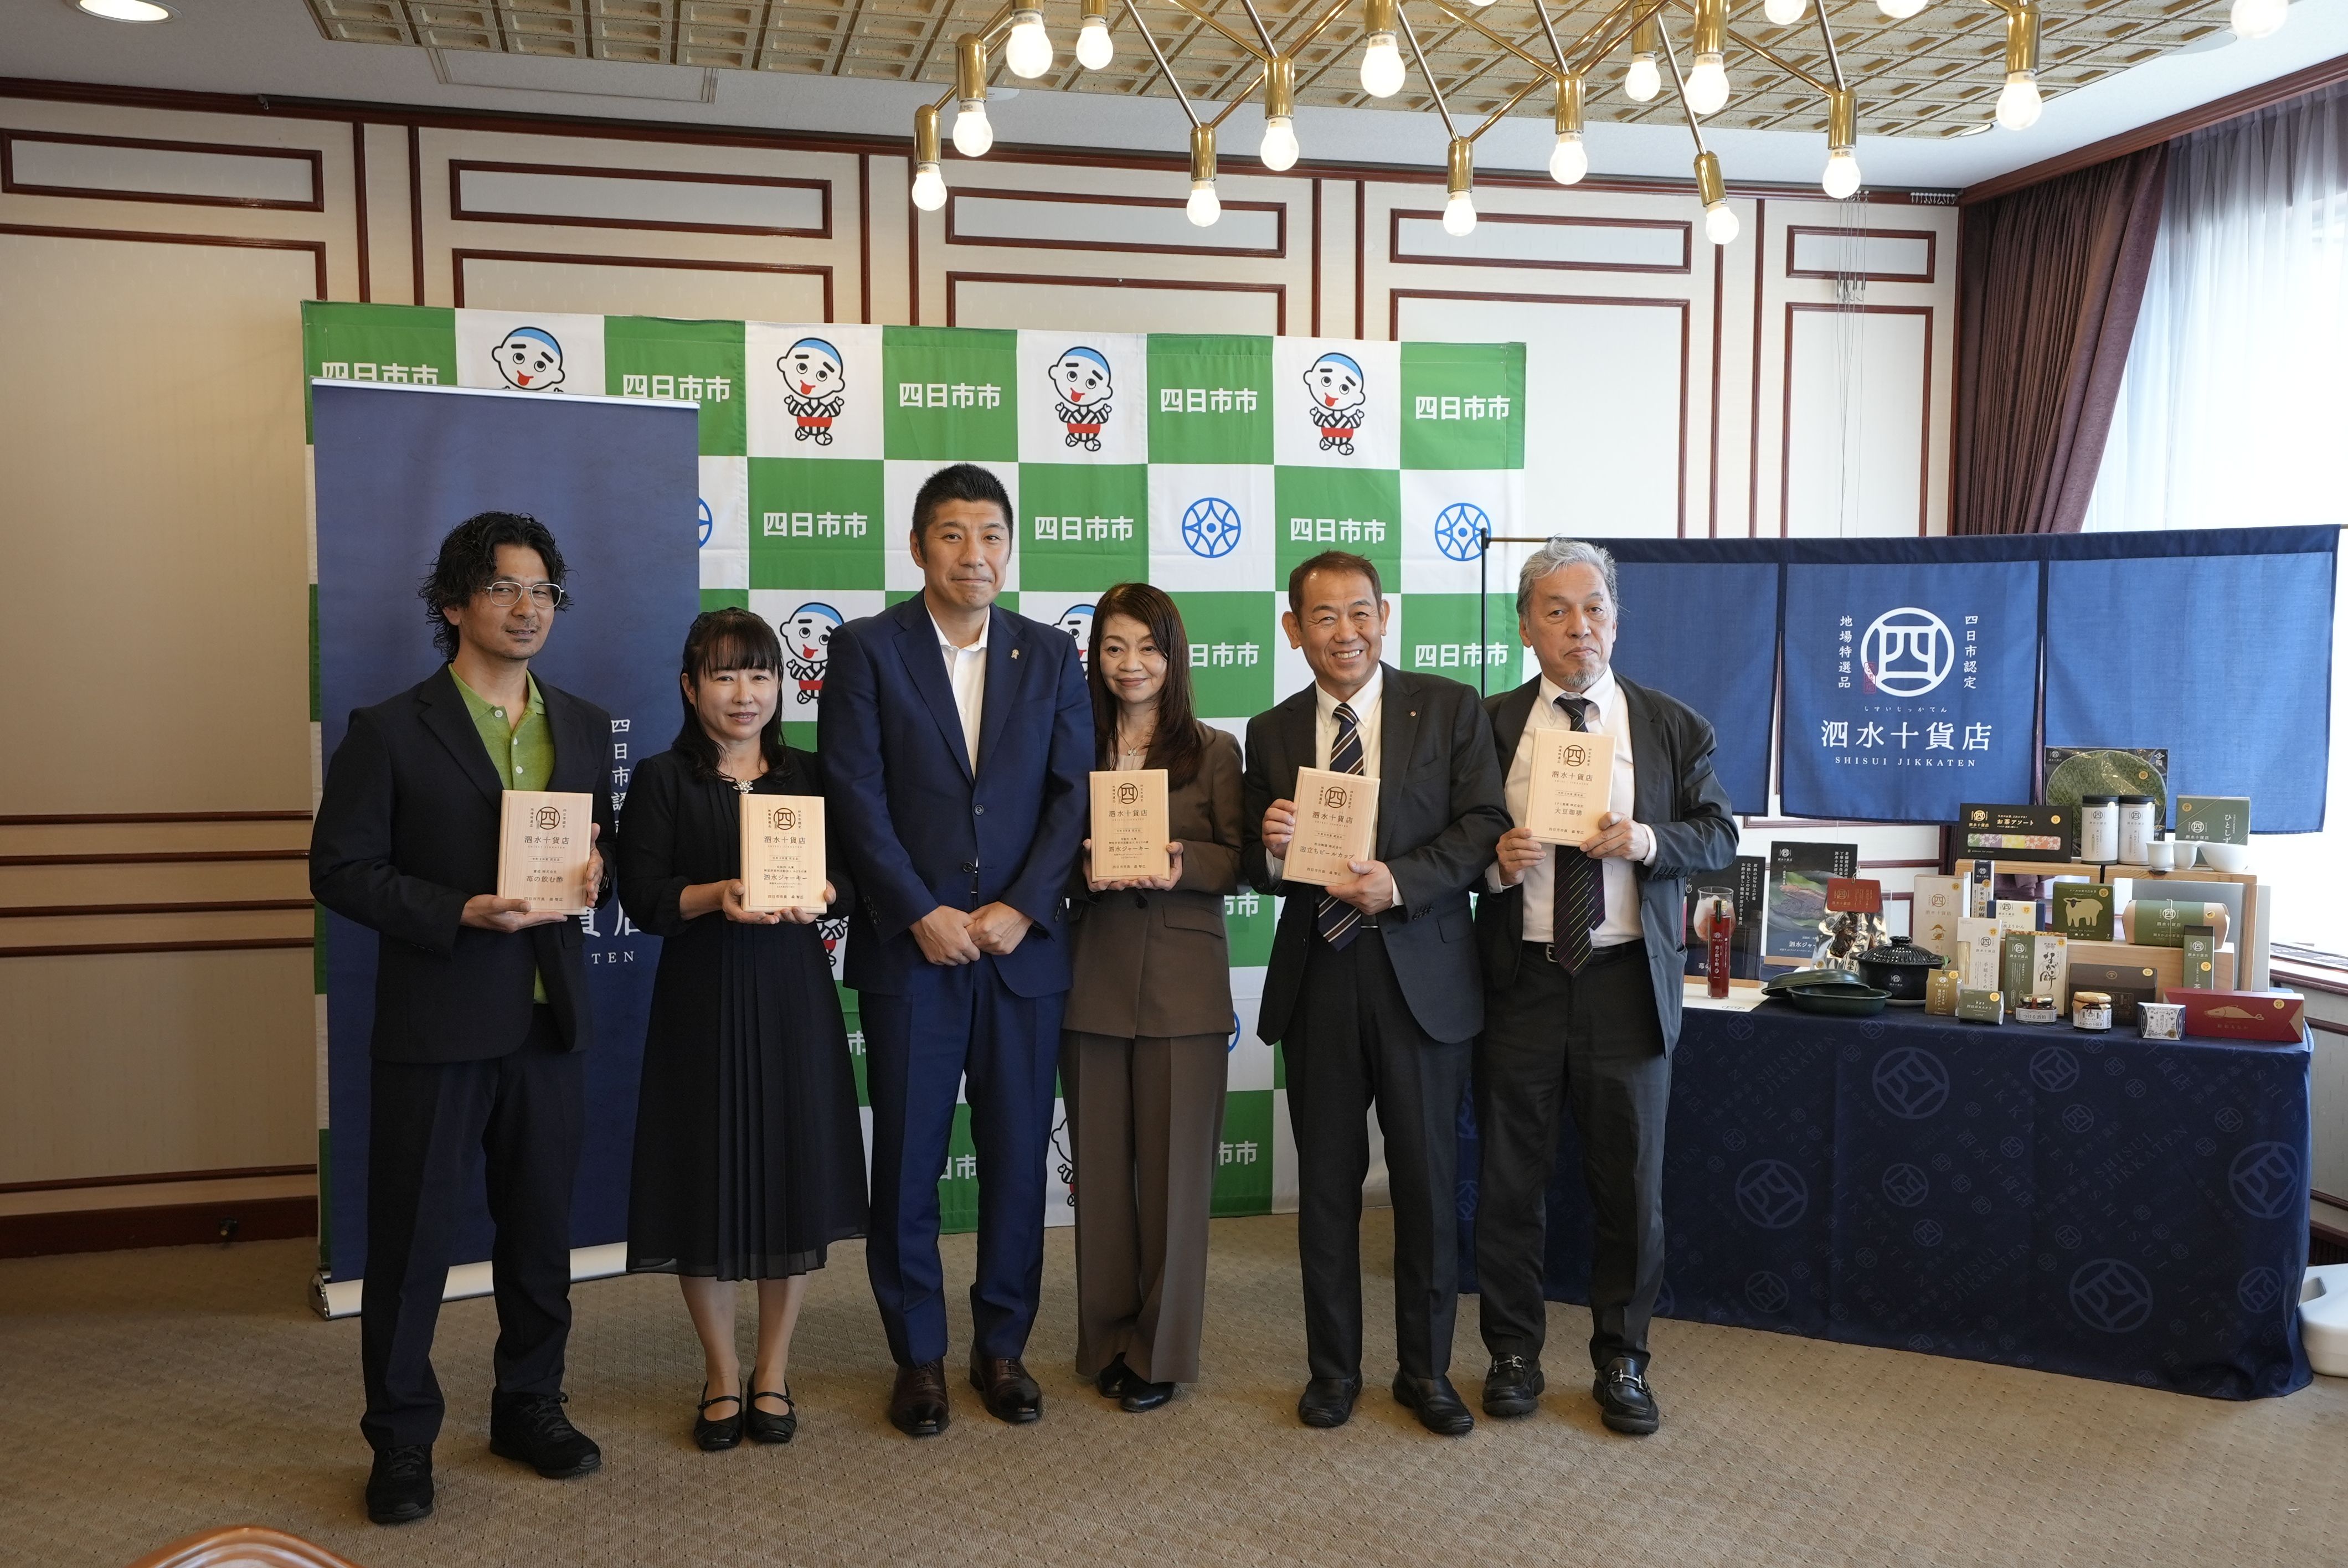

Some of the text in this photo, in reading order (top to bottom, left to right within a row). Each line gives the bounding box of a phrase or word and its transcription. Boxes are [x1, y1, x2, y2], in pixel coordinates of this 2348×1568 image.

[623, 375, 730, 402] 四日市市
[900, 383, 1001, 409] 四日市市
[1161, 388, 1258, 413] 四日市市
[1415, 395, 1510, 420] 四日市市
[763, 511, 868, 538] 四日市市
[1035, 516, 1134, 541] 四日市市
[1291, 518, 1386, 543] 四日市市
[1189, 642, 1259, 667] 日市市
[1415, 642, 1508, 667] 四日市市
[1838, 616, 1853, 689] 地場特選品
[1963, 615, 1979, 689] 四日市認定
[1821, 720, 1992, 751] 泗水十貨店
[1835, 756, 1976, 767] SHISUI JIKKATEN
[611, 719, 631, 833] 四日市認
